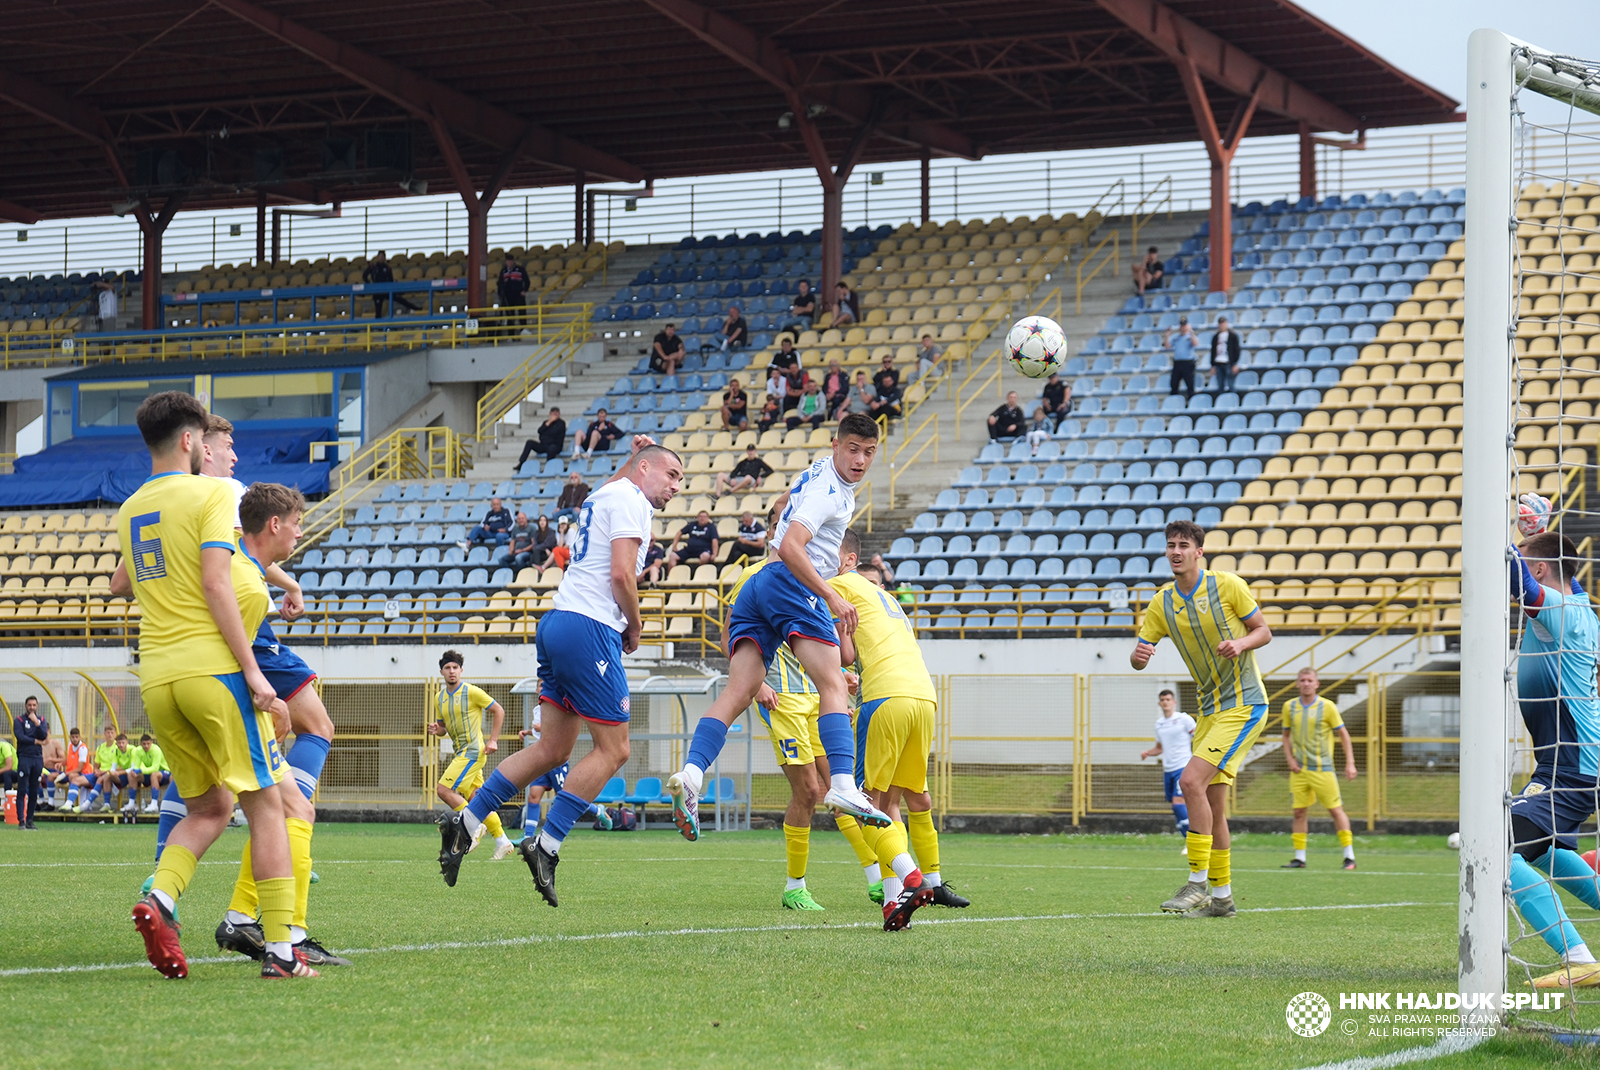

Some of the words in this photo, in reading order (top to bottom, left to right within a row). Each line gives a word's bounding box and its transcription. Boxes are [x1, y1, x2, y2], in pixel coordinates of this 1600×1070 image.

[130, 510, 167, 582] 6
[876, 590, 912, 633] 4
[267, 738, 281, 772] 6
[779, 738, 798, 759] 15
